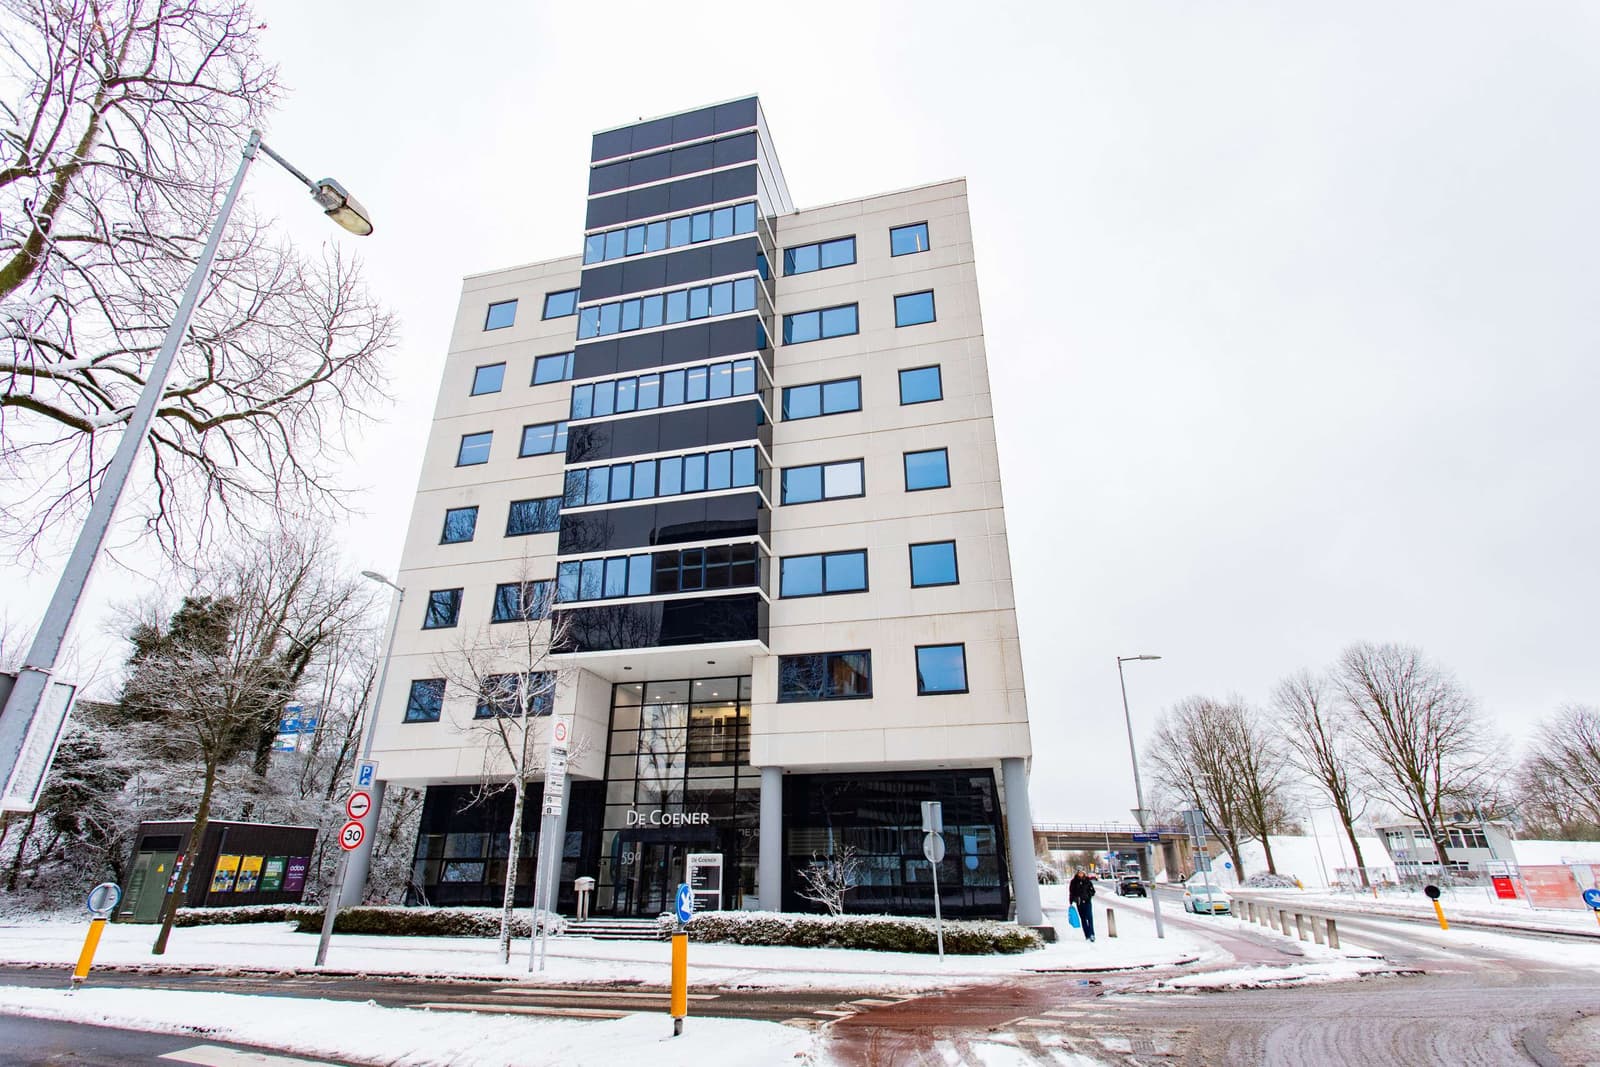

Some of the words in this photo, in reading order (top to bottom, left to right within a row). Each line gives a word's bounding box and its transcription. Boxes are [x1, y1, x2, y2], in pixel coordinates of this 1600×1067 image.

[626, 810, 646, 825] DE
[650, 810, 710, 825] COENER
[344, 829, 361, 841] 30
